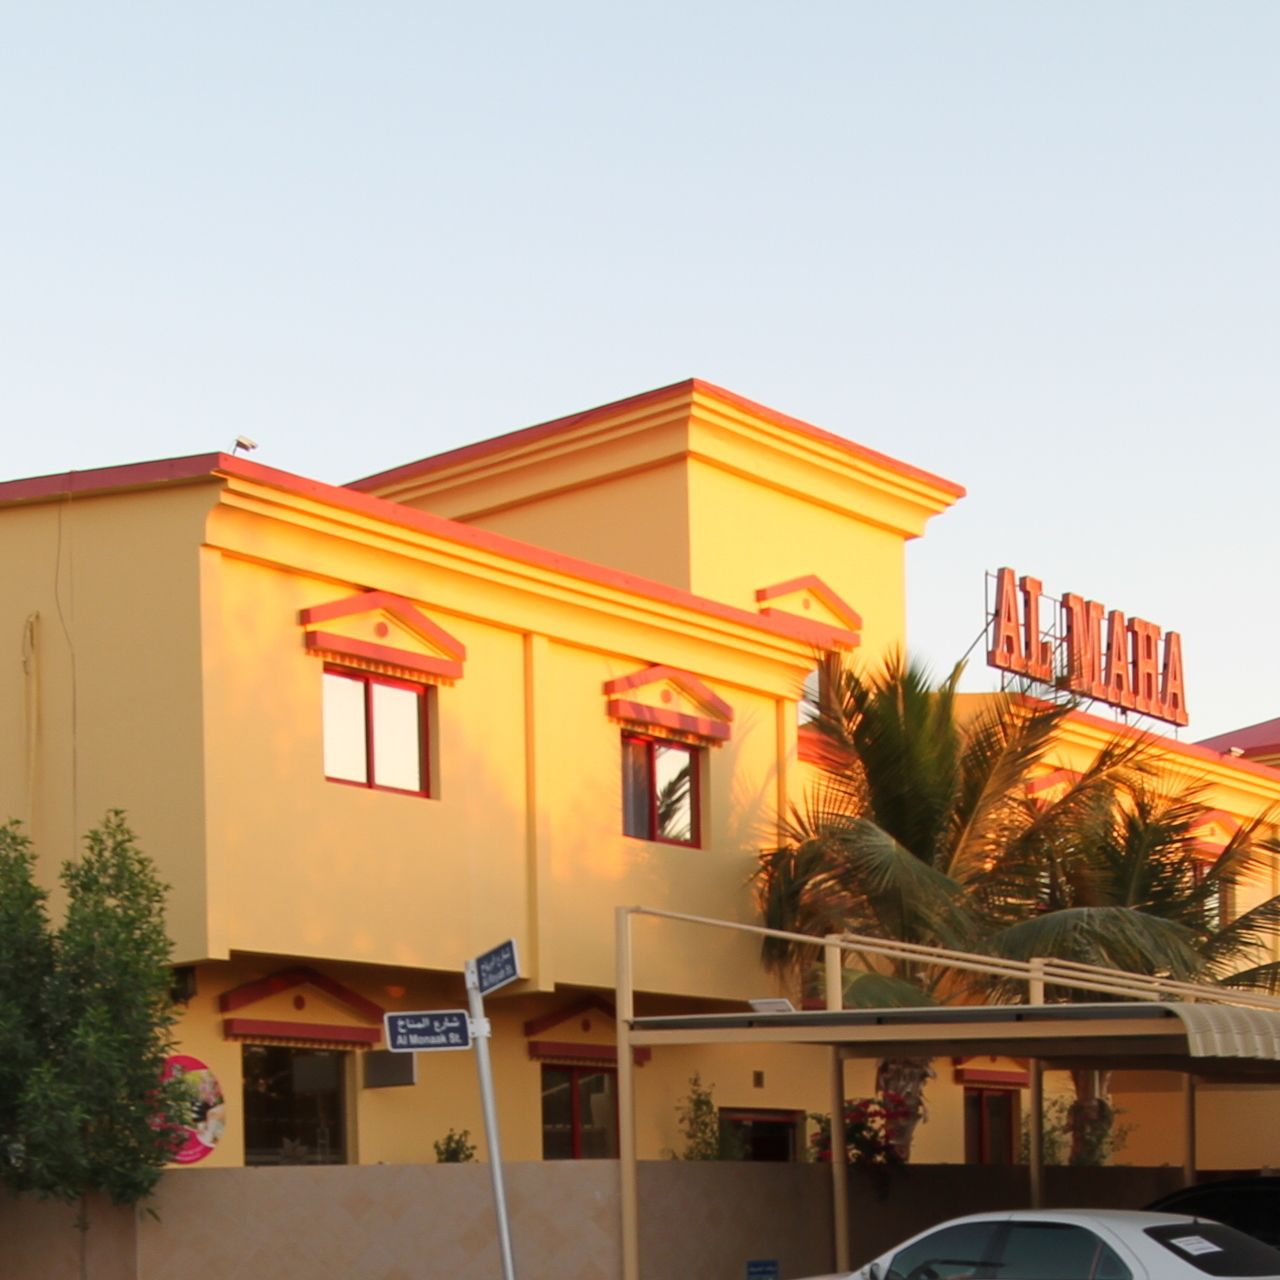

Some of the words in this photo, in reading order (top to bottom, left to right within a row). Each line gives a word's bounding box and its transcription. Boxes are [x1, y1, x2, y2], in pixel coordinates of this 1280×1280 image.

[987, 567, 1054, 682] AL
[1061, 592, 1189, 727] MAHA
[433, 1016, 460, 1033] شارع
[396, 1034, 408, 1046] Al
[448, 1032, 463, 1044] St.
